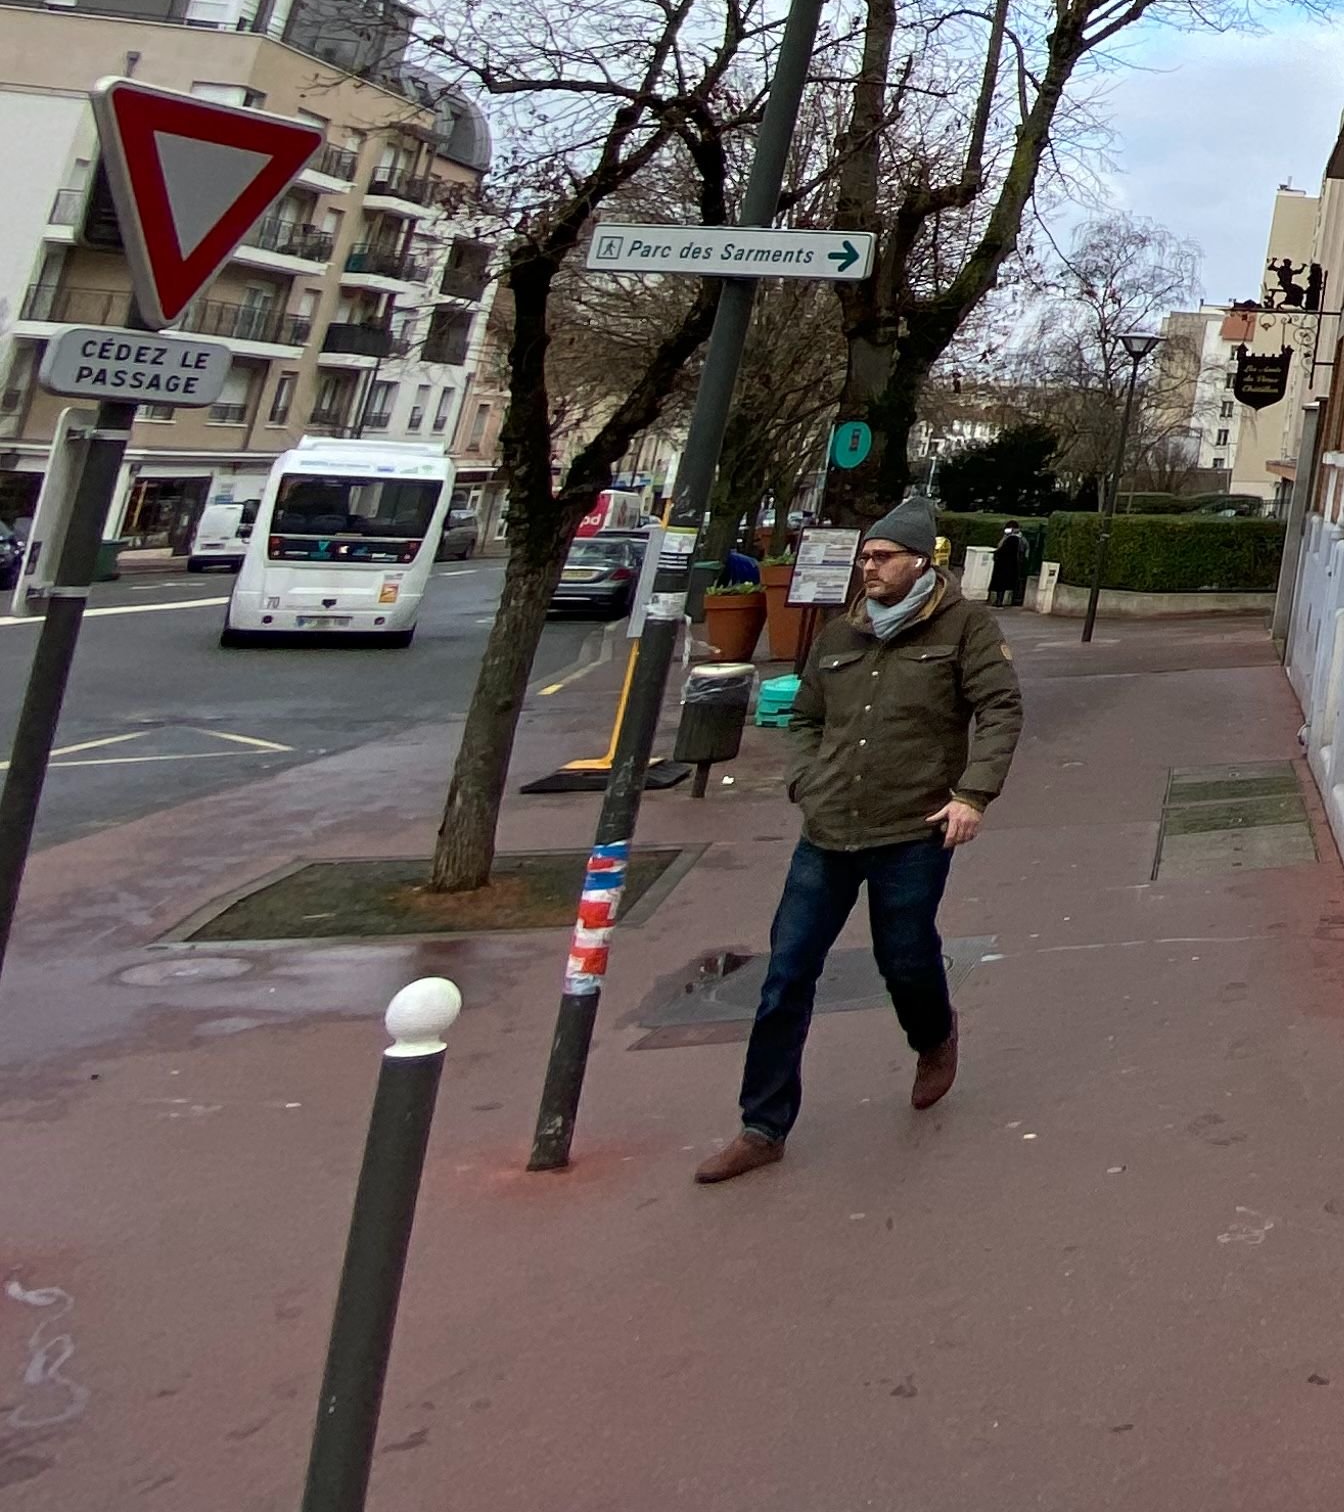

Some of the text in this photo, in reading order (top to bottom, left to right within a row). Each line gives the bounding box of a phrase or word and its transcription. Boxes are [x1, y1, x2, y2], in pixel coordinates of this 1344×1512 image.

[627, 239, 815, 264] Parc des Sarments
[81, 338, 211, 370] CÉDEZ LE
[75, 366, 200, 395] PASSAGE
[579, 513, 602, 529] pd
[266, 596, 281, 609] 70
